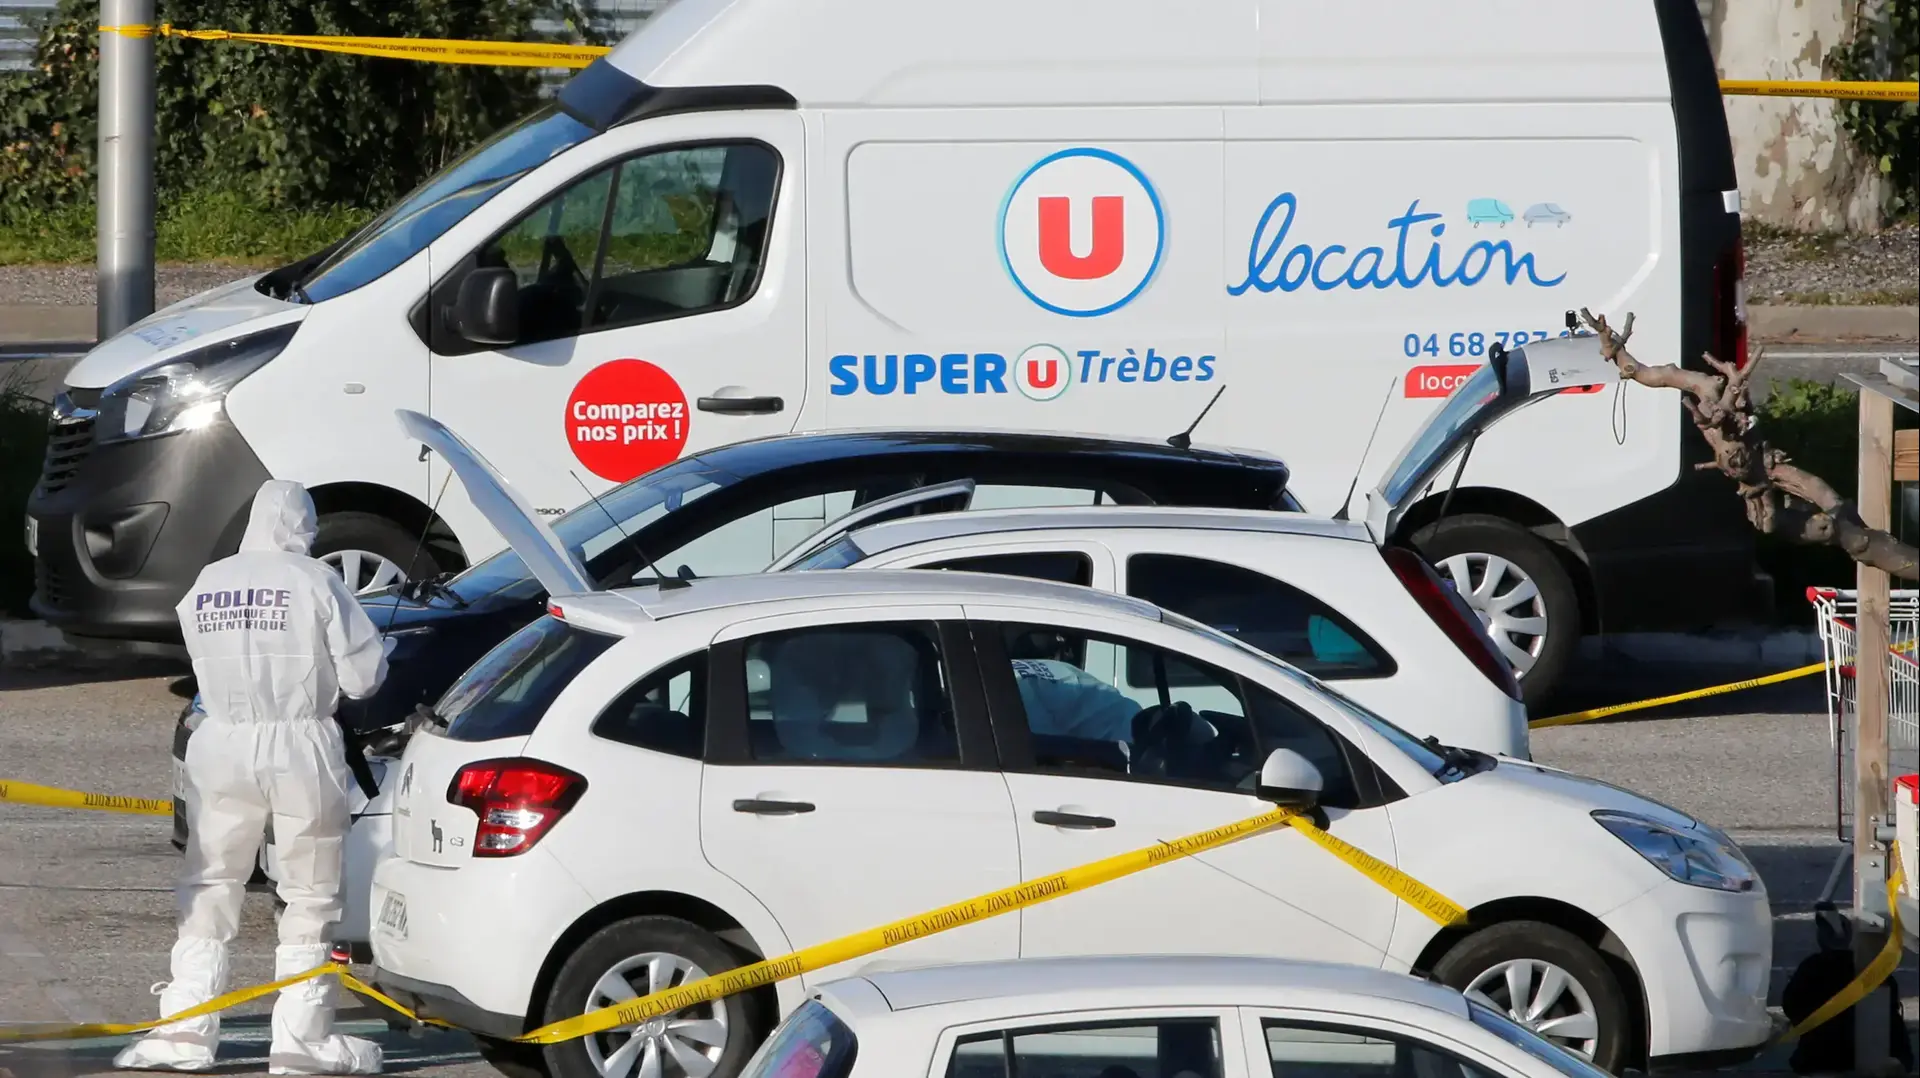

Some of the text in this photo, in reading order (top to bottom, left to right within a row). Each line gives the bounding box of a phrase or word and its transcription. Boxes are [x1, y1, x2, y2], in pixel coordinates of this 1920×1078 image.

[410, 46, 447, 54] INTERDITE
[552, 52, 572, 60] ZONE
[1824, 88, 1864, 96] NATIONALE
[1867, 89, 1886, 97] ZONE
[1038, 196, 1124, 280] U
[1226, 192, 1567, 296] location
[1404, 333, 1440, 358] 04
[1449, 332, 1485, 357] 68
[828, 348, 1216, 396] SUPER U Trèbes
[573, 401, 684, 424] Comparez
[577, 424, 617, 441] nos
[623, 421, 668, 445] prix
[196, 588, 291, 611] POLICE
[196, 608, 289, 623] TECHNIQUE ET
[198, 619, 288, 634] SCIENTIFIQUE
[83, 792, 133, 808] INTERDITE
[1147, 841, 1185, 863] POLICE
[883, 921, 921, 945] POLICE
[921, 903, 979, 934] NATIONALE
[984, 892, 1014, 914] ZONE
[1014, 876, 1069, 904] INTERDITE
[617, 1001, 654, 1025] POLICE
[656, 983, 713, 1013] NATIONALE
[719, 972, 750, 994] ZONE
[749, 956, 804, 984] INTERDITE
